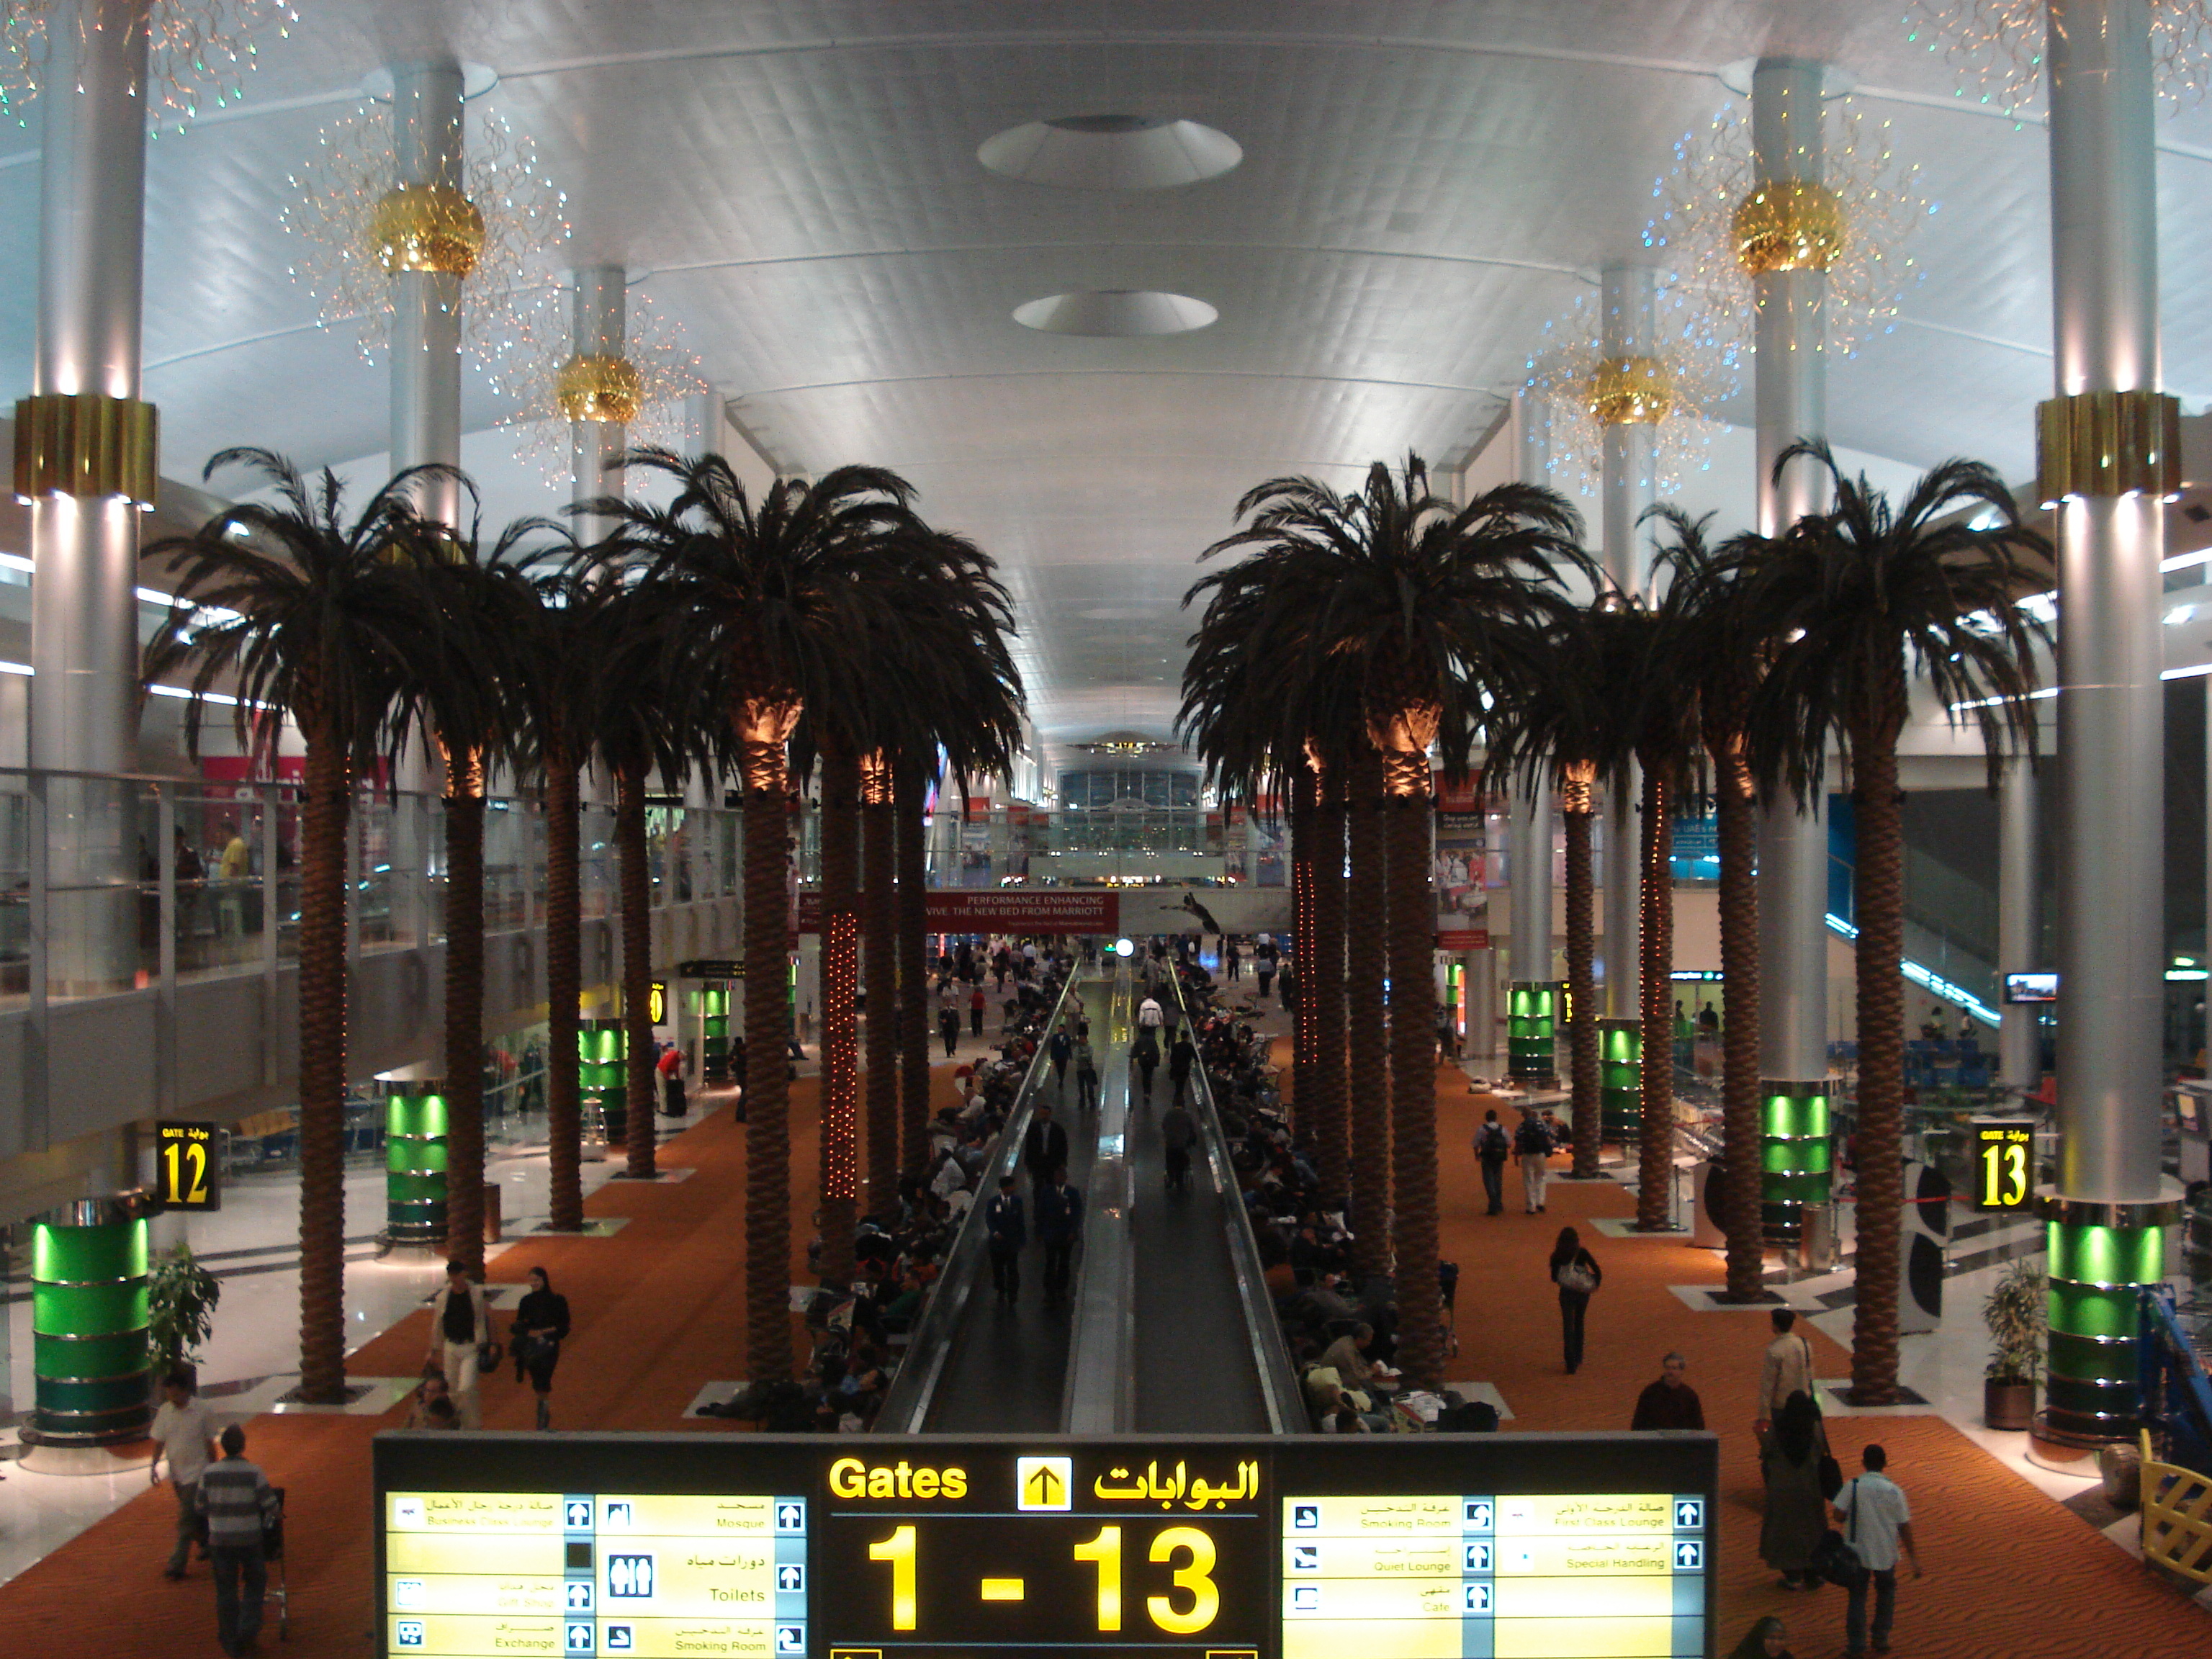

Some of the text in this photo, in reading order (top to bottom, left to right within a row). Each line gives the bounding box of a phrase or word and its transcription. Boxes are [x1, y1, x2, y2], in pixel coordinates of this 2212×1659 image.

[967, 896, 1104, 905] PERFORMANCE ENHANCING
[953, 907, 972, 915] THE
[974, 907, 997, 915] NEW
[999, 907, 1019, 915] BED
[1021, 907, 1050, 915] FROM
[1052, 907, 1104, 915] MARRIOTT
[162, 1128, 184, 1138] GATE
[1980, 1130, 2004, 1140] GATE
[163, 1142, 207, 1203] 12
[1982, 1144, 2026, 1206] 13
[829, 1458, 968, 1498] Gates
[1094, 1460, 1259, 1510] البوابات
[428, 1516, 476, 1525] Business
[716, 1518, 765, 1529] Mosque
[1361, 1518, 1452, 1530] Smoking Room
[1555, 1517, 1665, 1529] First Class Lounge
[687, 1555, 765, 1570] دورات مياه
[1375, 1561, 1451, 1573] Quiet Lounge
[1566, 1558, 1665, 1570] Special Handling
[868, 1525, 1220, 1634] 1 - 13
[709, 1588, 765, 1602] Toilets
[1423, 1601, 1450, 1612] Cafe
[495, 1637, 556, 1651] Exchange
[675, 1640, 766, 1653] Smoking Room
